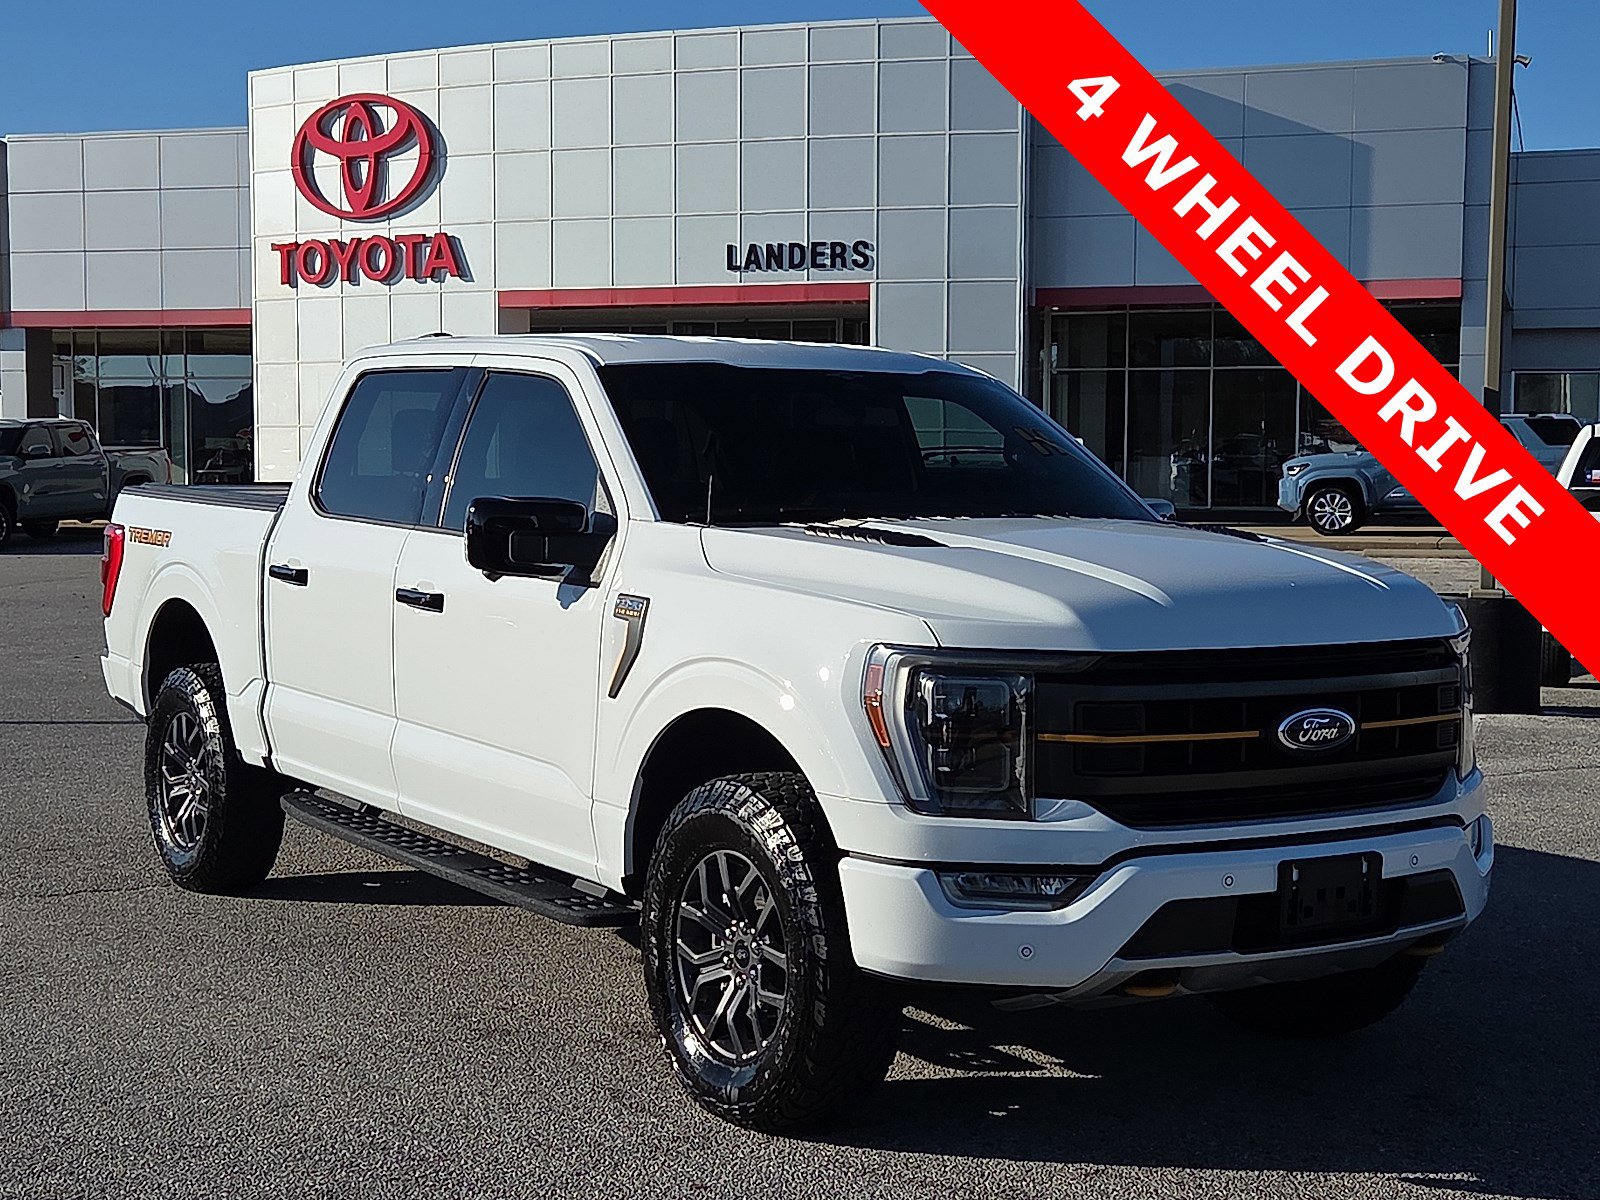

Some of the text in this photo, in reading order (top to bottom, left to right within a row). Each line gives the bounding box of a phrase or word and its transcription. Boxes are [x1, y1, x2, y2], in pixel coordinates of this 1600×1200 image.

[271, 232, 460, 285] TOYOTA
[726, 240, 873, 271] LANDERS
[128, 526, 172, 548] TREMOR
[1298, 717, 1341, 742] Ford
